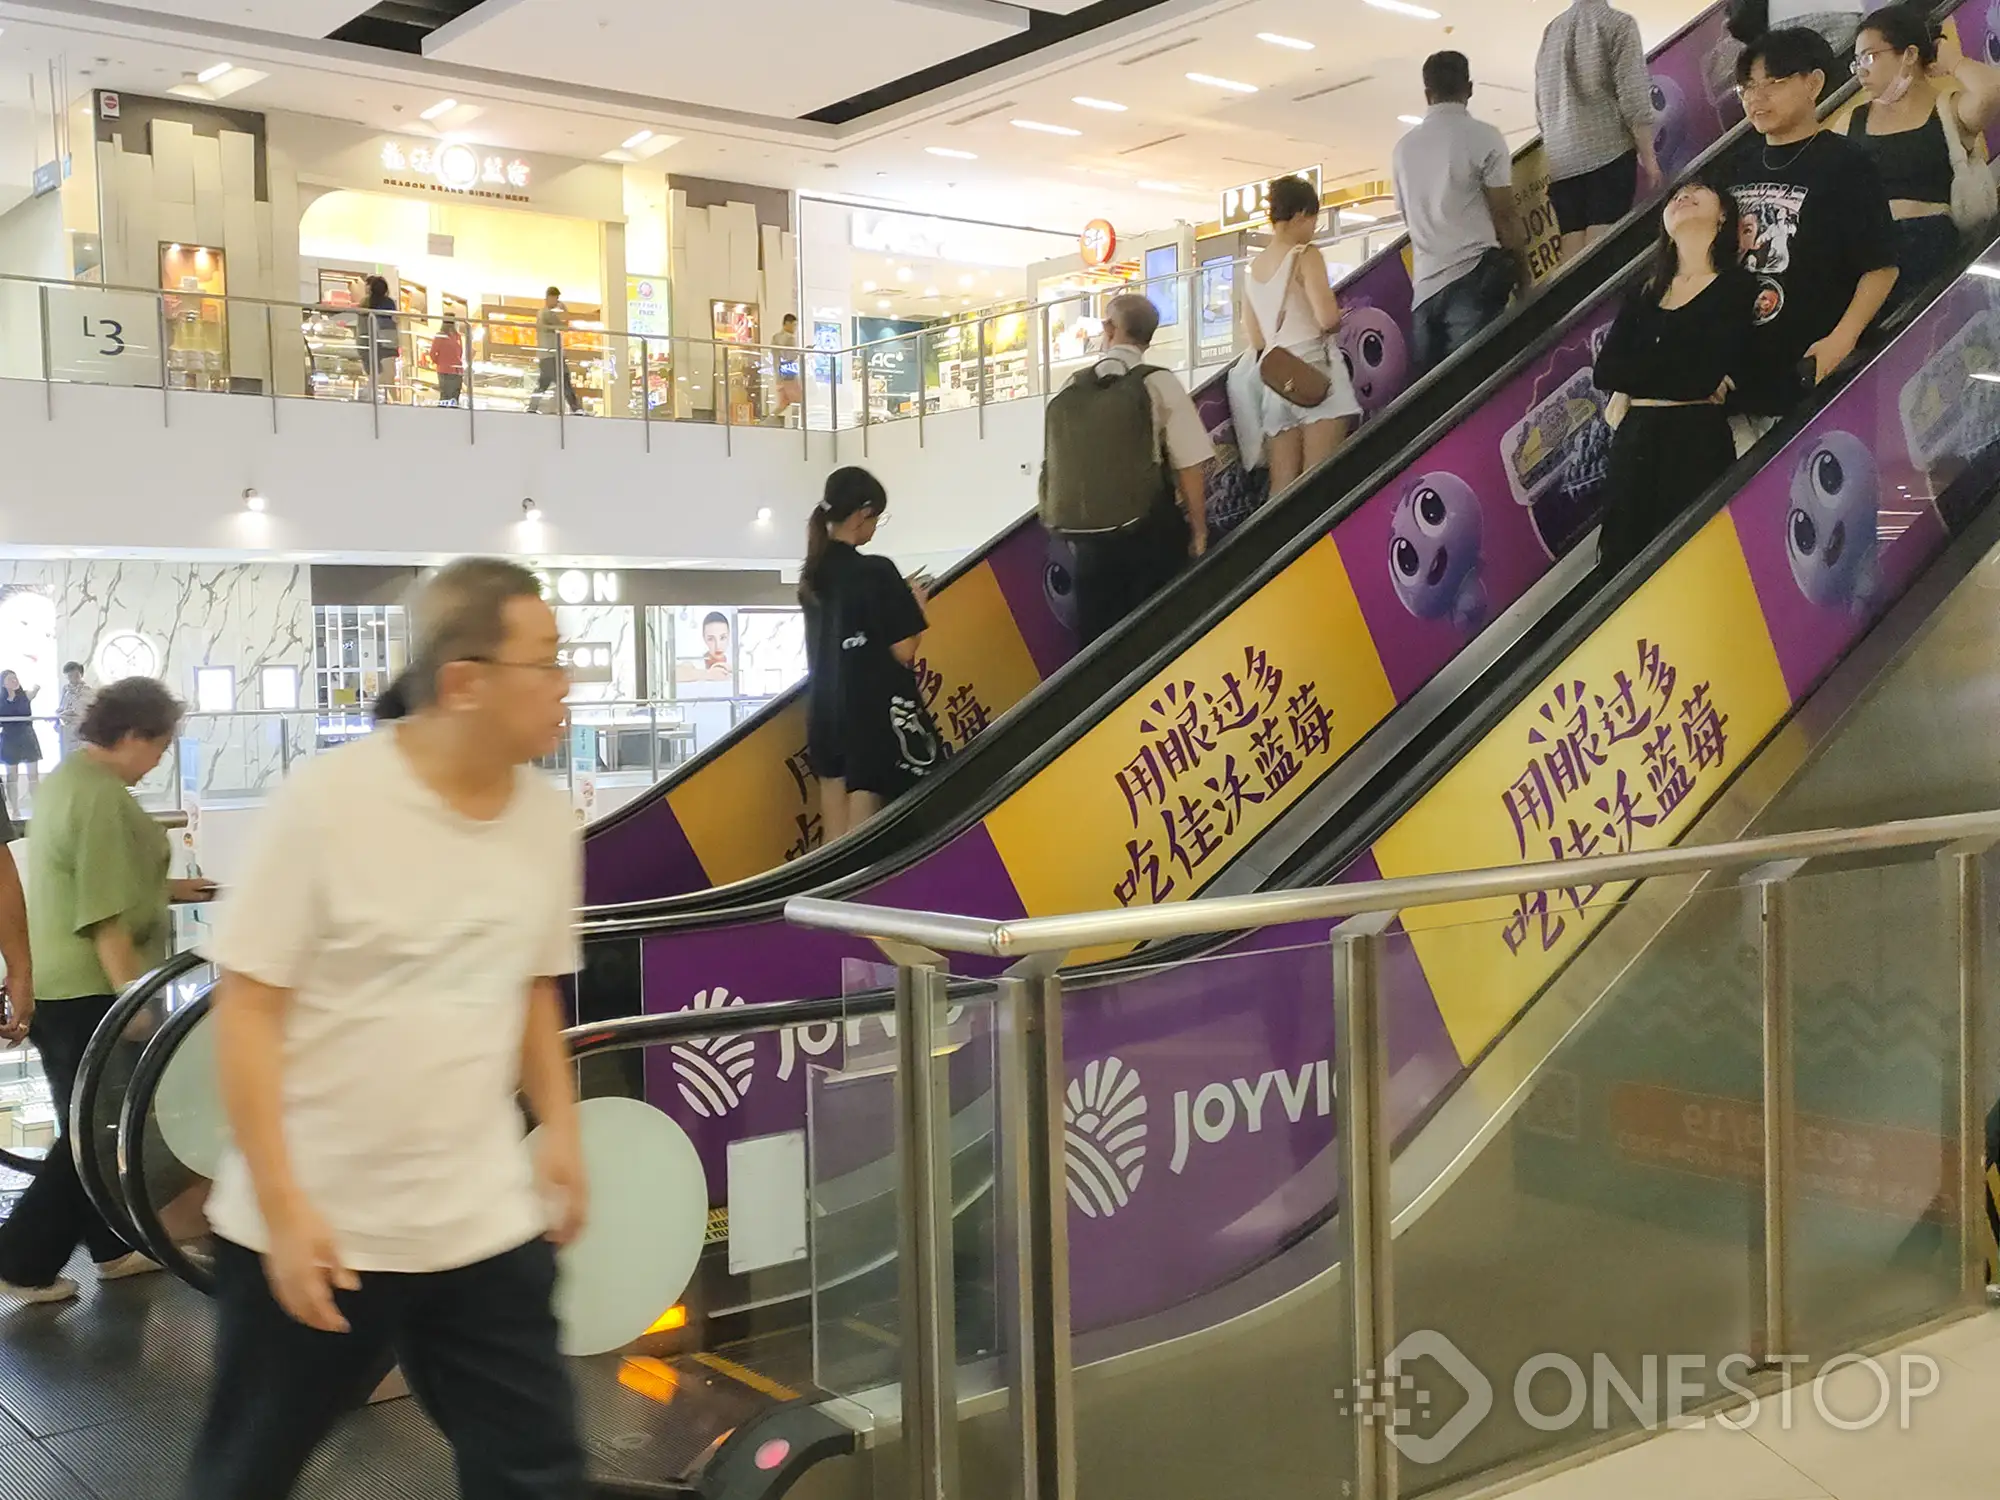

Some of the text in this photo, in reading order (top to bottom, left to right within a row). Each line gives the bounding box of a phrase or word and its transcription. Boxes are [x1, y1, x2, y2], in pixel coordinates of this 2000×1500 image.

[1113, 680, 1335, 908] 吃佳沃蓝莓
[1114, 645, 1284, 830] 用眼过多
[1501, 638, 1677, 861] 用眼过多
[1169, 1059, 1338, 1176] JOYVI
